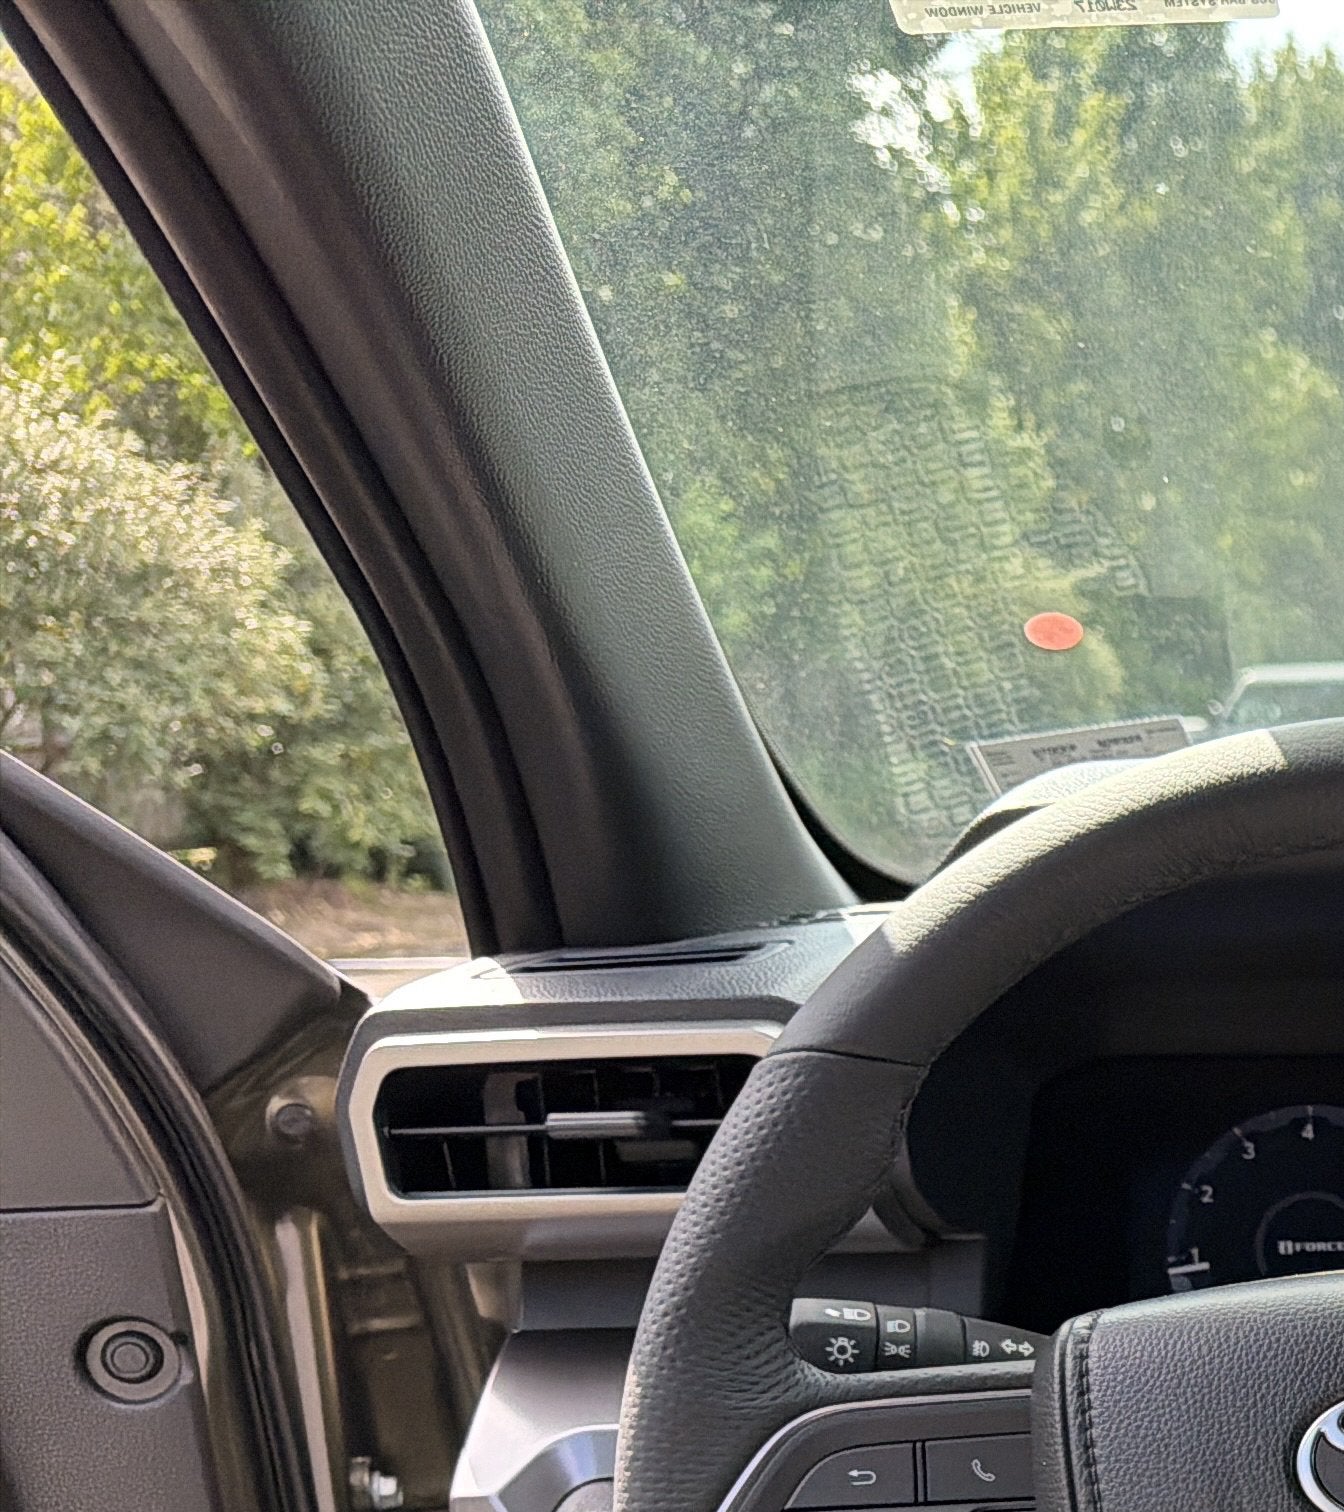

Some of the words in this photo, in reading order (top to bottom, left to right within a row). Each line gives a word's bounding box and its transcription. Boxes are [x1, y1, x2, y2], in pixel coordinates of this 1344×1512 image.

[1301, 1122, 1315, 1141] 4
[1241, 1142, 1255, 1160] 3
[1200, 1184, 1214, 1203] 2
